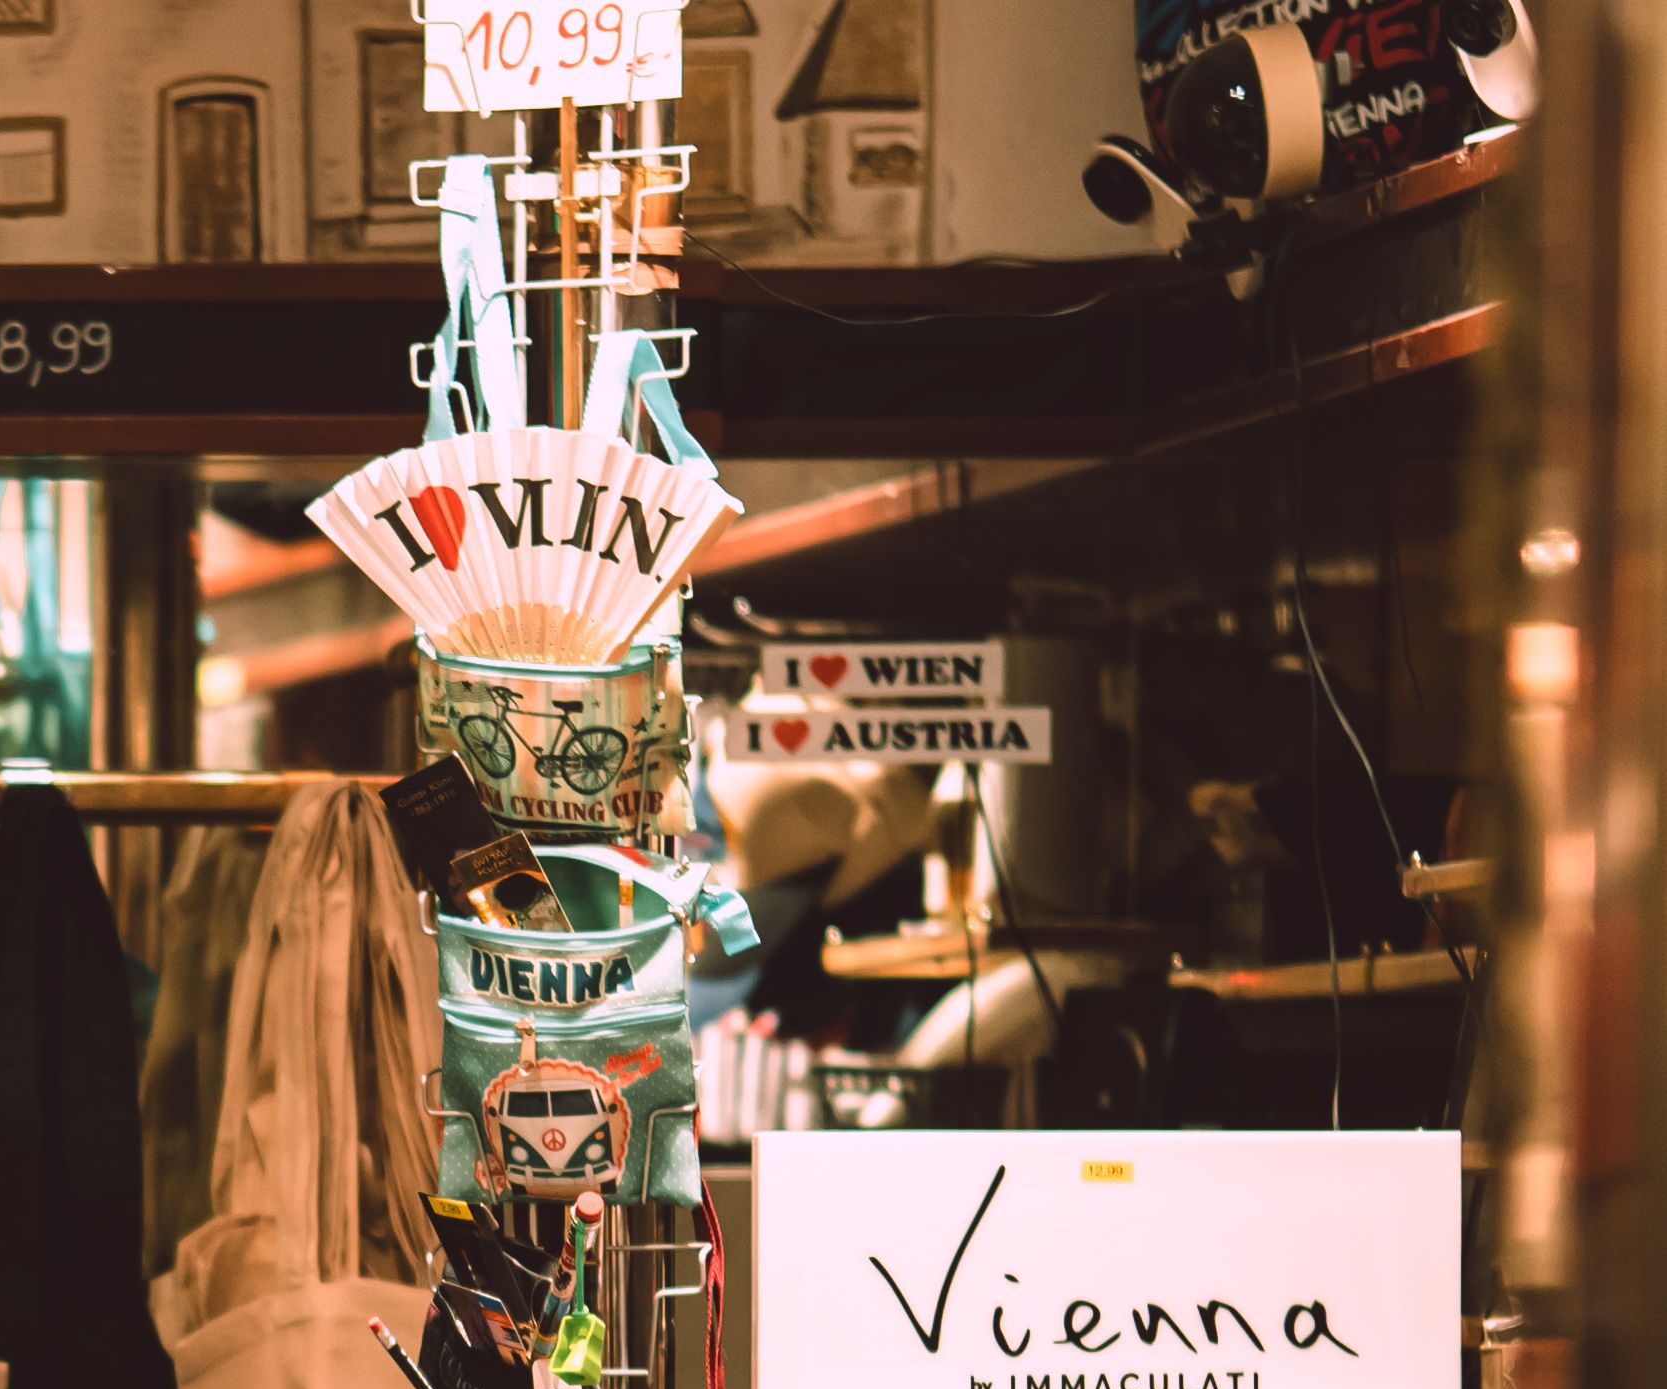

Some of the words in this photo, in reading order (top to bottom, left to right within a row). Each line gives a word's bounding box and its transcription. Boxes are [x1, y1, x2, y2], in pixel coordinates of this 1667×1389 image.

[461, 3, 623, 86] 10,99
[786, 658, 800, 688] I
[861, 655, 984, 687] WIEN
[747, 722, 761, 752] I
[824, 719, 1030, 752] AUSTRIA
[511, 795, 606, 823] CYCLING
[611, 790, 664, 818] CLUB
[469, 946, 635, 1006] VIENNA
[869, 1164, 1359, 1358] Vienna
